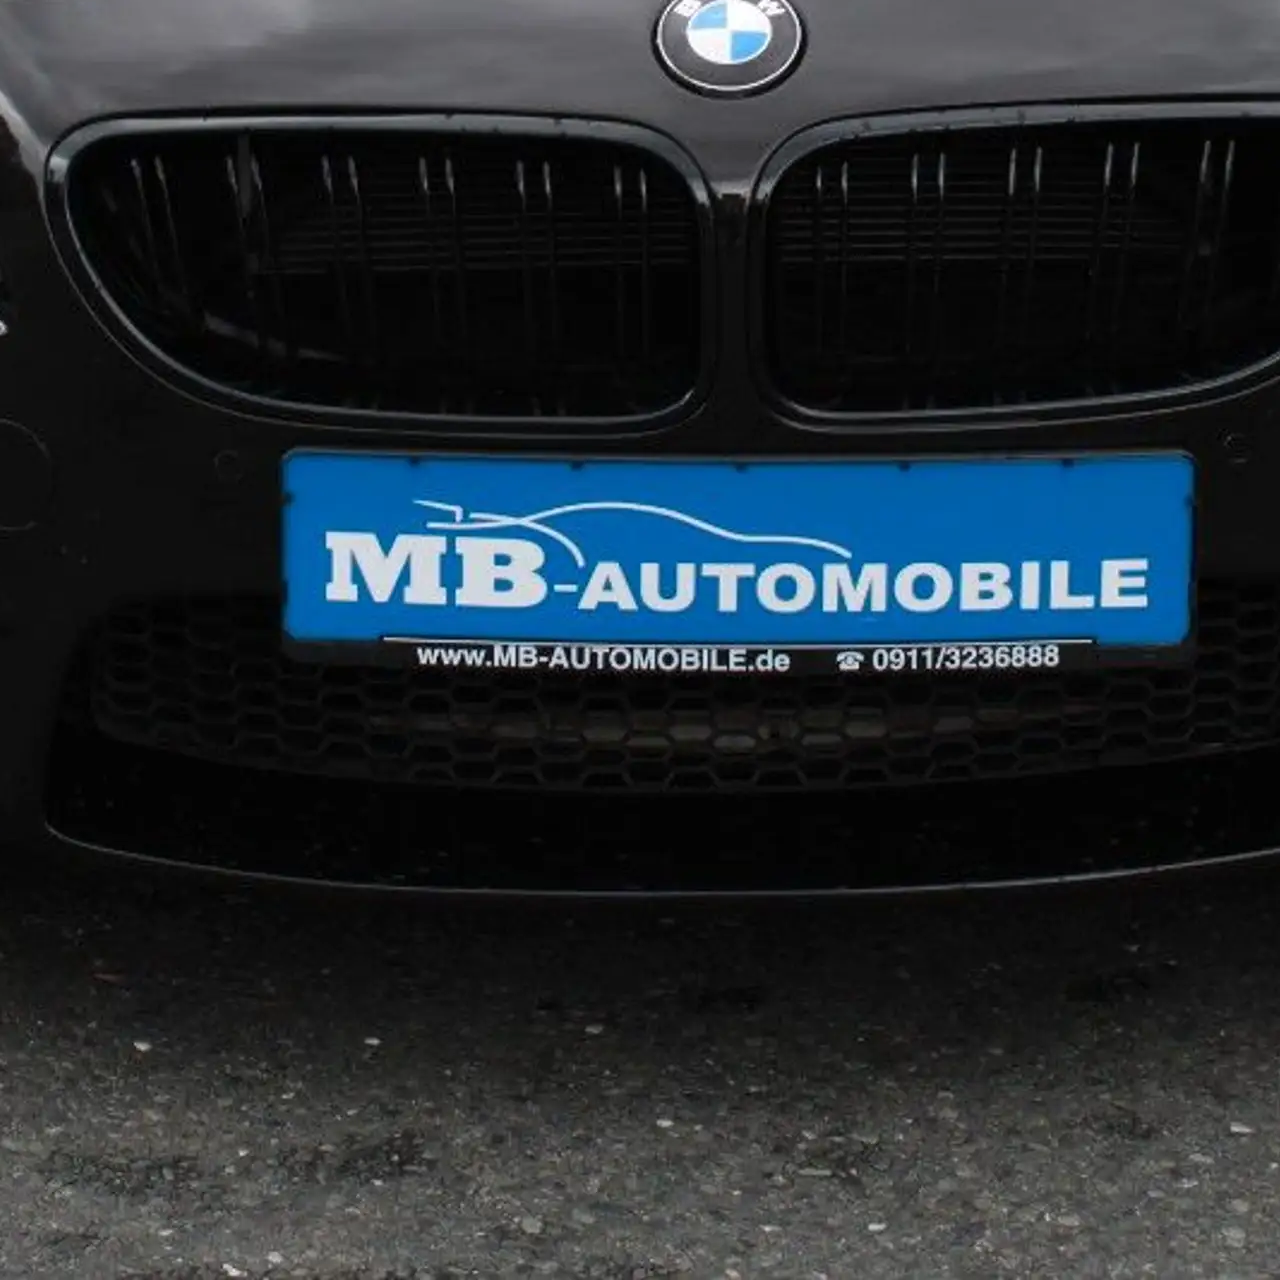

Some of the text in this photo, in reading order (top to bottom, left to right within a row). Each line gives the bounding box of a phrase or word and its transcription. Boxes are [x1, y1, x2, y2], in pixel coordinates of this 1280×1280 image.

[325, 531, 1148, 613] MB-AUTOMOBILE
[416, 644, 1060, 672] www.MB-AUTOMOBILE.de 0911/3236888
